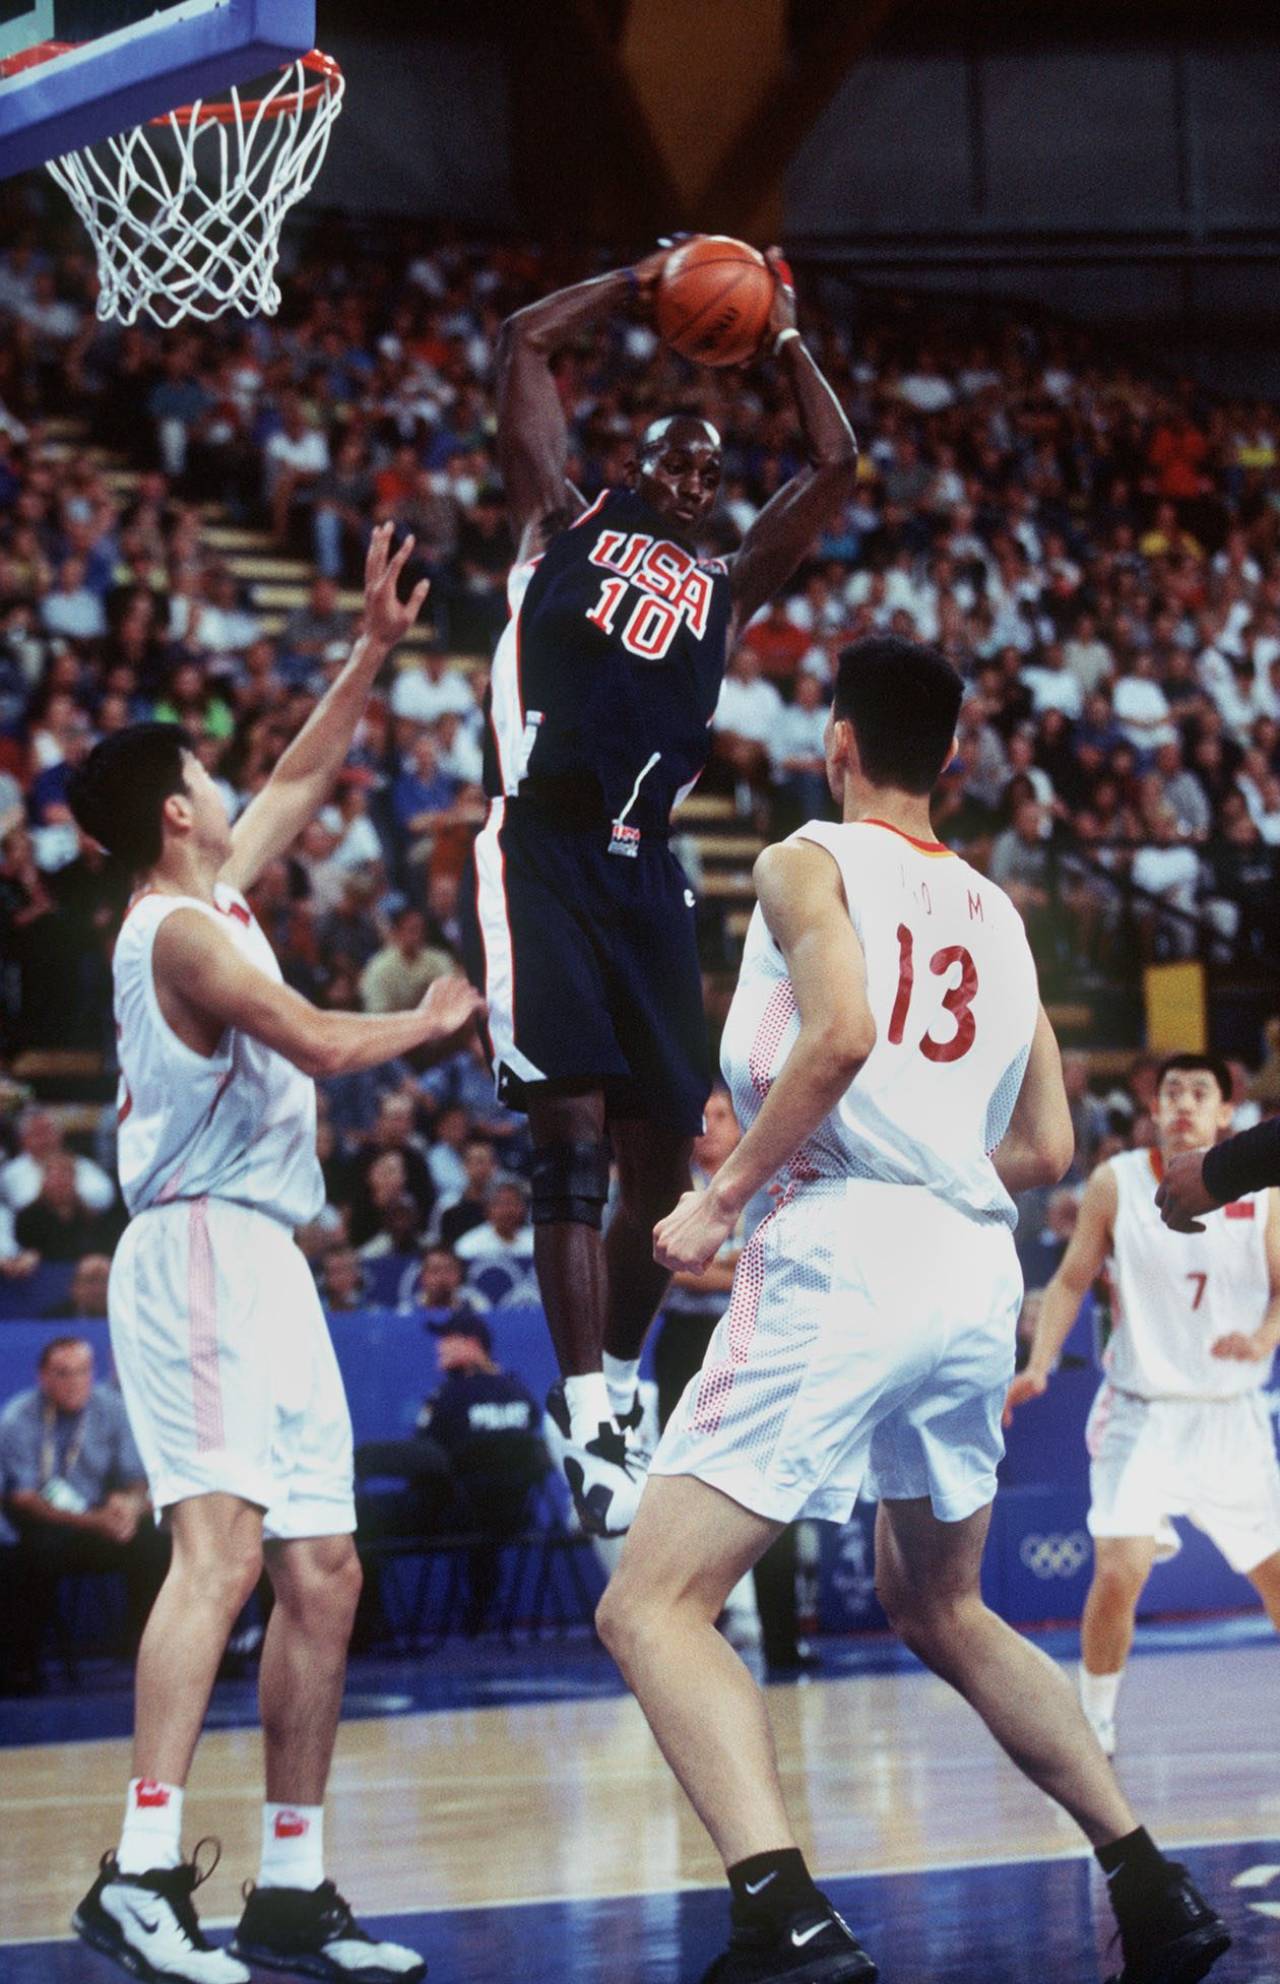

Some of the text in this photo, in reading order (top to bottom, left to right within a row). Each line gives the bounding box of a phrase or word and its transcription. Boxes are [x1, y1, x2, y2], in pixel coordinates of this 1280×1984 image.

[585, 577, 681, 660] 10
[588, 529, 714, 641] USA
[888, 922, 978, 1063] 13
[1185, 1271, 1208, 1310] 7
